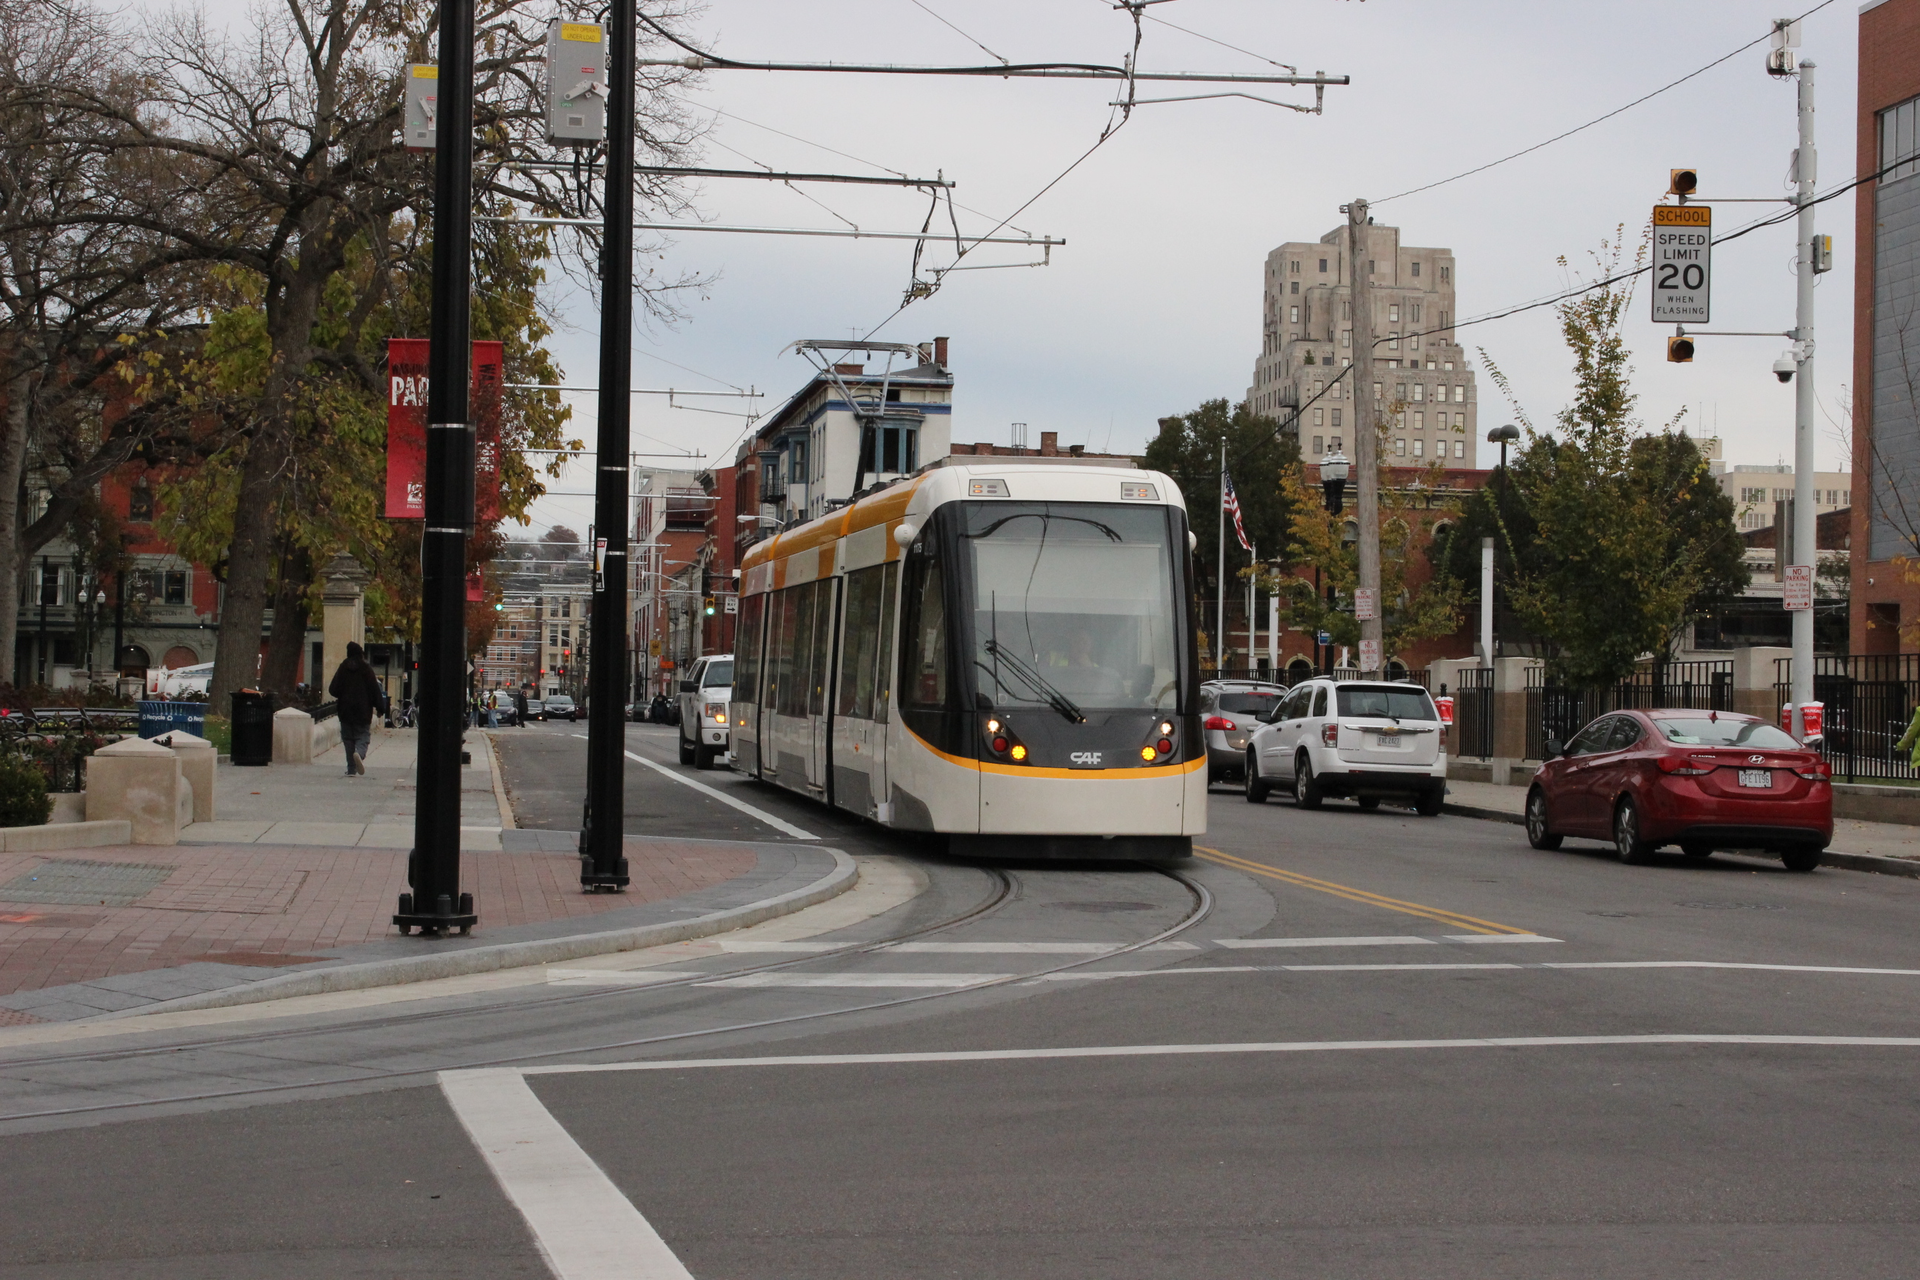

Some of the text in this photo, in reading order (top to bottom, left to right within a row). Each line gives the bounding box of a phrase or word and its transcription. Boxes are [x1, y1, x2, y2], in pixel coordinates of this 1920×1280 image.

[1658, 210, 1708, 222] SCHOOL
[1659, 234, 1706, 246] SPEED
[1664, 249, 1700, 260] LIMIT
[1658, 264, 1704, 290] 20
[1070, 752, 1102, 764] CAF
[1740, 774, 1770, 784] GFE 1196
